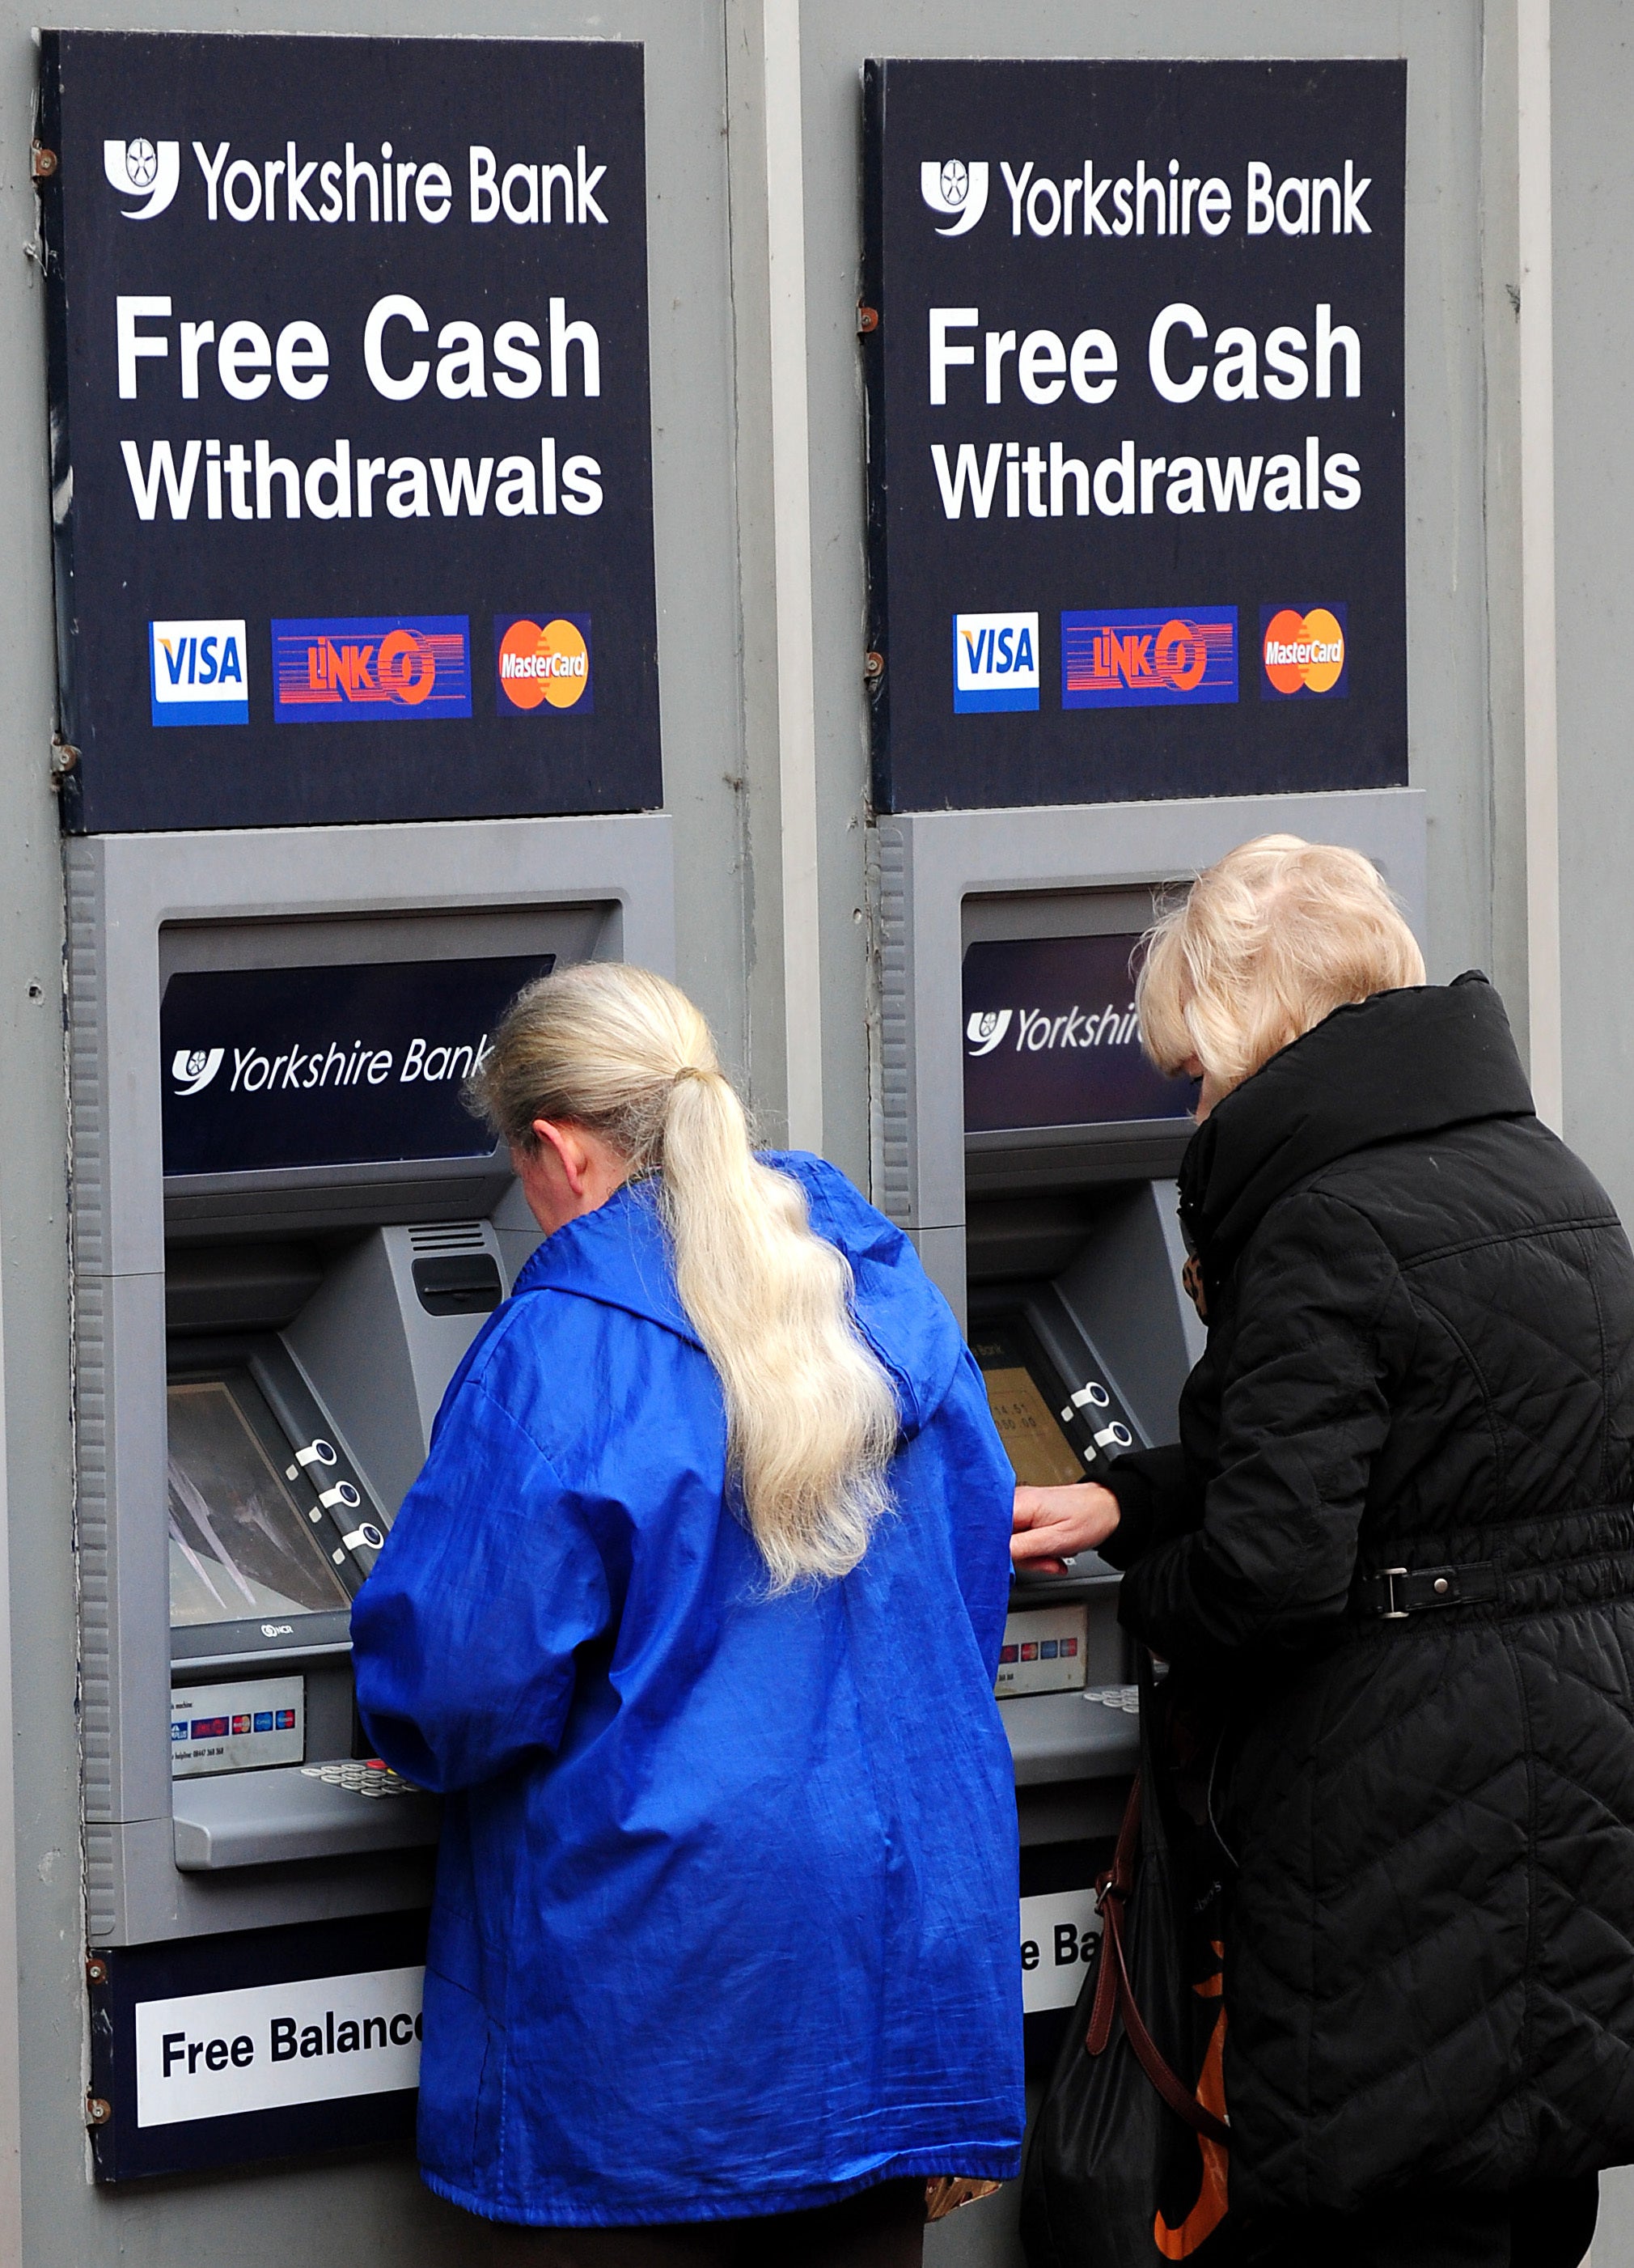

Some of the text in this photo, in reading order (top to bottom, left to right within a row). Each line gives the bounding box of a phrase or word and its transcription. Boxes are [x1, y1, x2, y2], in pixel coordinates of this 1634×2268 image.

[192, 141, 609, 224] Yorkshire Bank
[1000, 158, 1373, 237] Yorkshire Bank
[116, 294, 600, 401] Free Cash
[929, 303, 1361, 405] Free Cash
[120, 437, 603, 521] Withdrawals
[930, 436, 1361, 519] Withdrawals
[158, 636, 243, 685] VISA
[501, 650, 585, 680] MasterCard
[961, 628, 1035, 675] VISA
[1264, 638, 1342, 668] MasterCard
[230, 1040, 393, 1092] Yorkshire
[162, 2032, 254, 2078] Free
